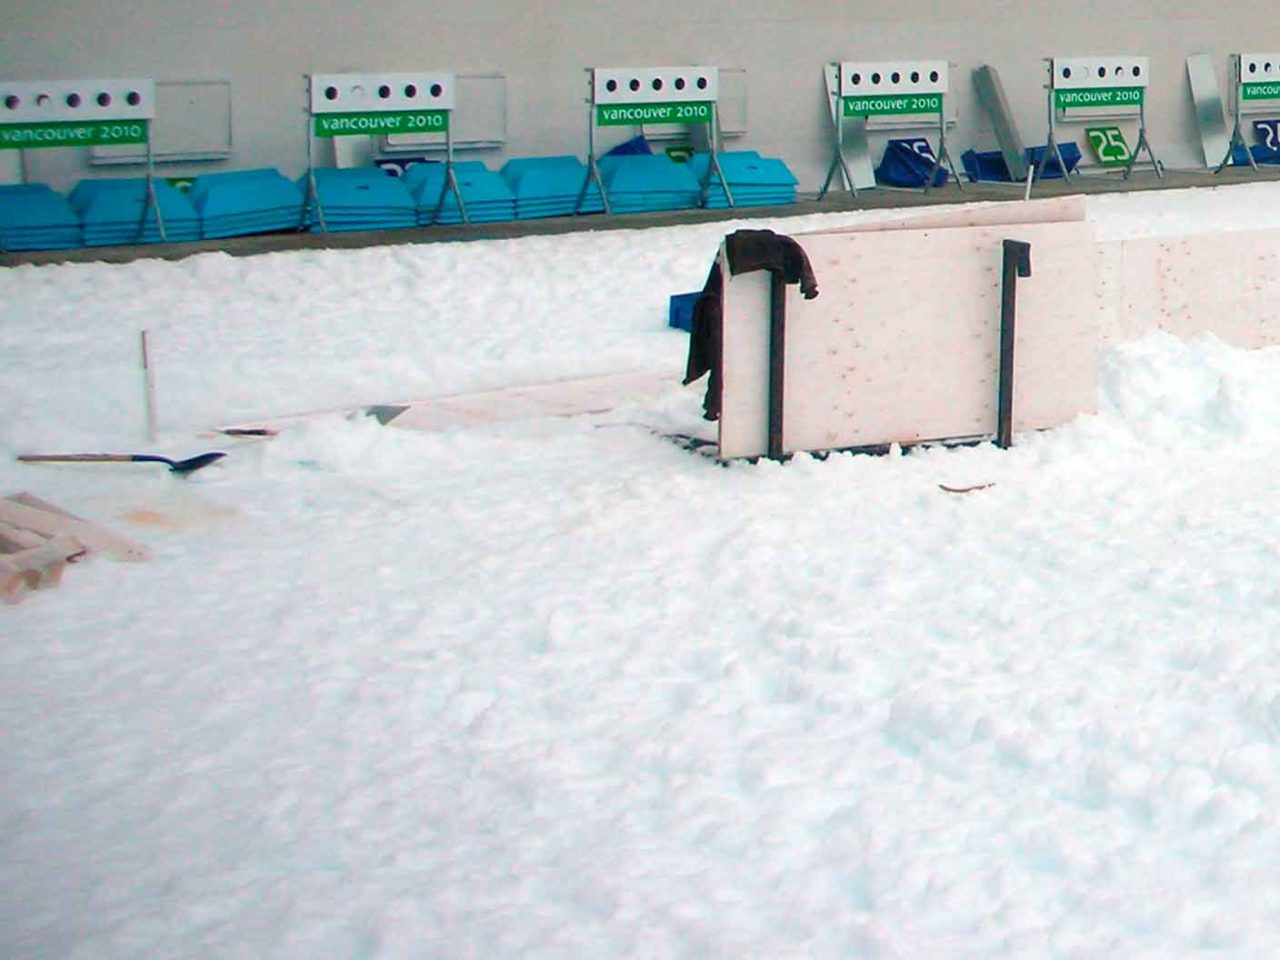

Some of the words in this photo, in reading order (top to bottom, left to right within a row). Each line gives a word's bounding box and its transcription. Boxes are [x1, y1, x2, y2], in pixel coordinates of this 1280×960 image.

[1060, 91, 1112, 102] vancouver
[1115, 90, 1140, 101] 2010
[848, 100, 909, 111] vancouver
[911, 98, 939, 109] 2010
[603, 107, 673, 120] vancouver
[676, 105, 708, 117] 2010
[322, 116, 401, 130] vancouver
[407, 114, 443, 128] 2010
[1, 127, 95, 142] vancouver
[101, 125, 142, 138] 2010
[1088, 129, 1130, 161] 25
